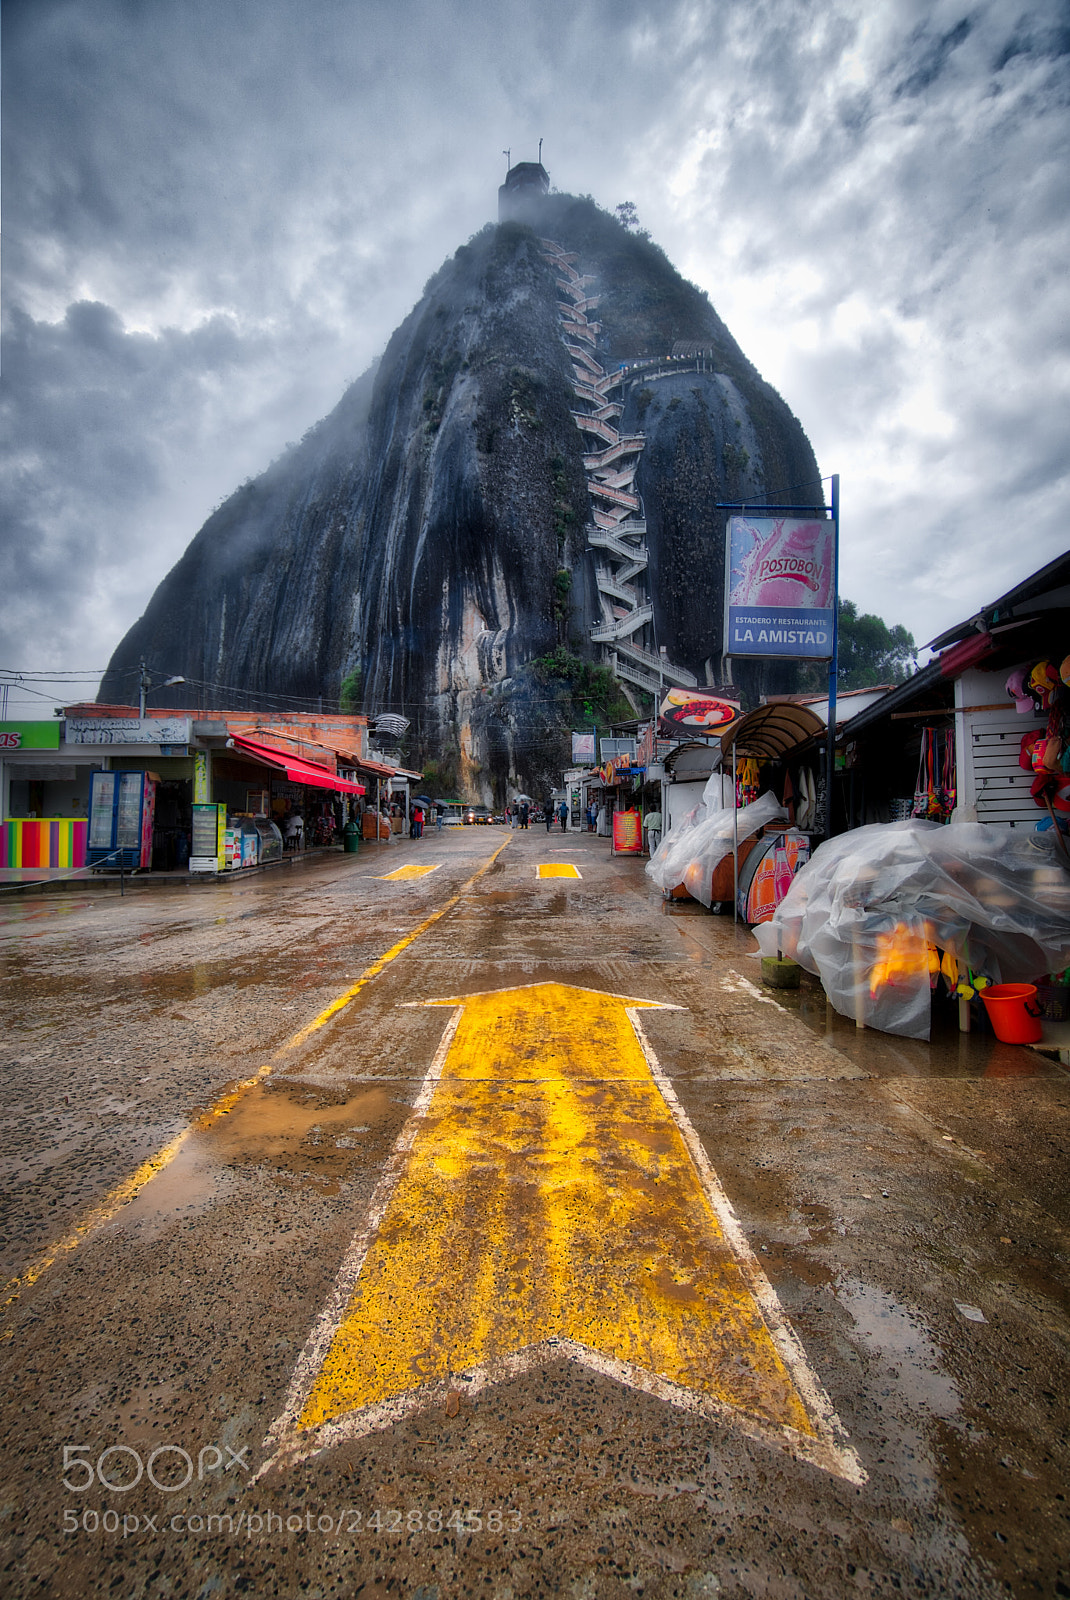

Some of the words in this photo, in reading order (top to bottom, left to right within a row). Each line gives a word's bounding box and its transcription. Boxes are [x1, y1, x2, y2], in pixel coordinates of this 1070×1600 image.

[735, 616, 771, 625] ESTADERO
[772, 617, 778, 625] Y
[778, 618, 827, 626] RESTAURANTE
[735, 629, 754, 642] LA
[758, 629, 827, 644] AMISTAD
